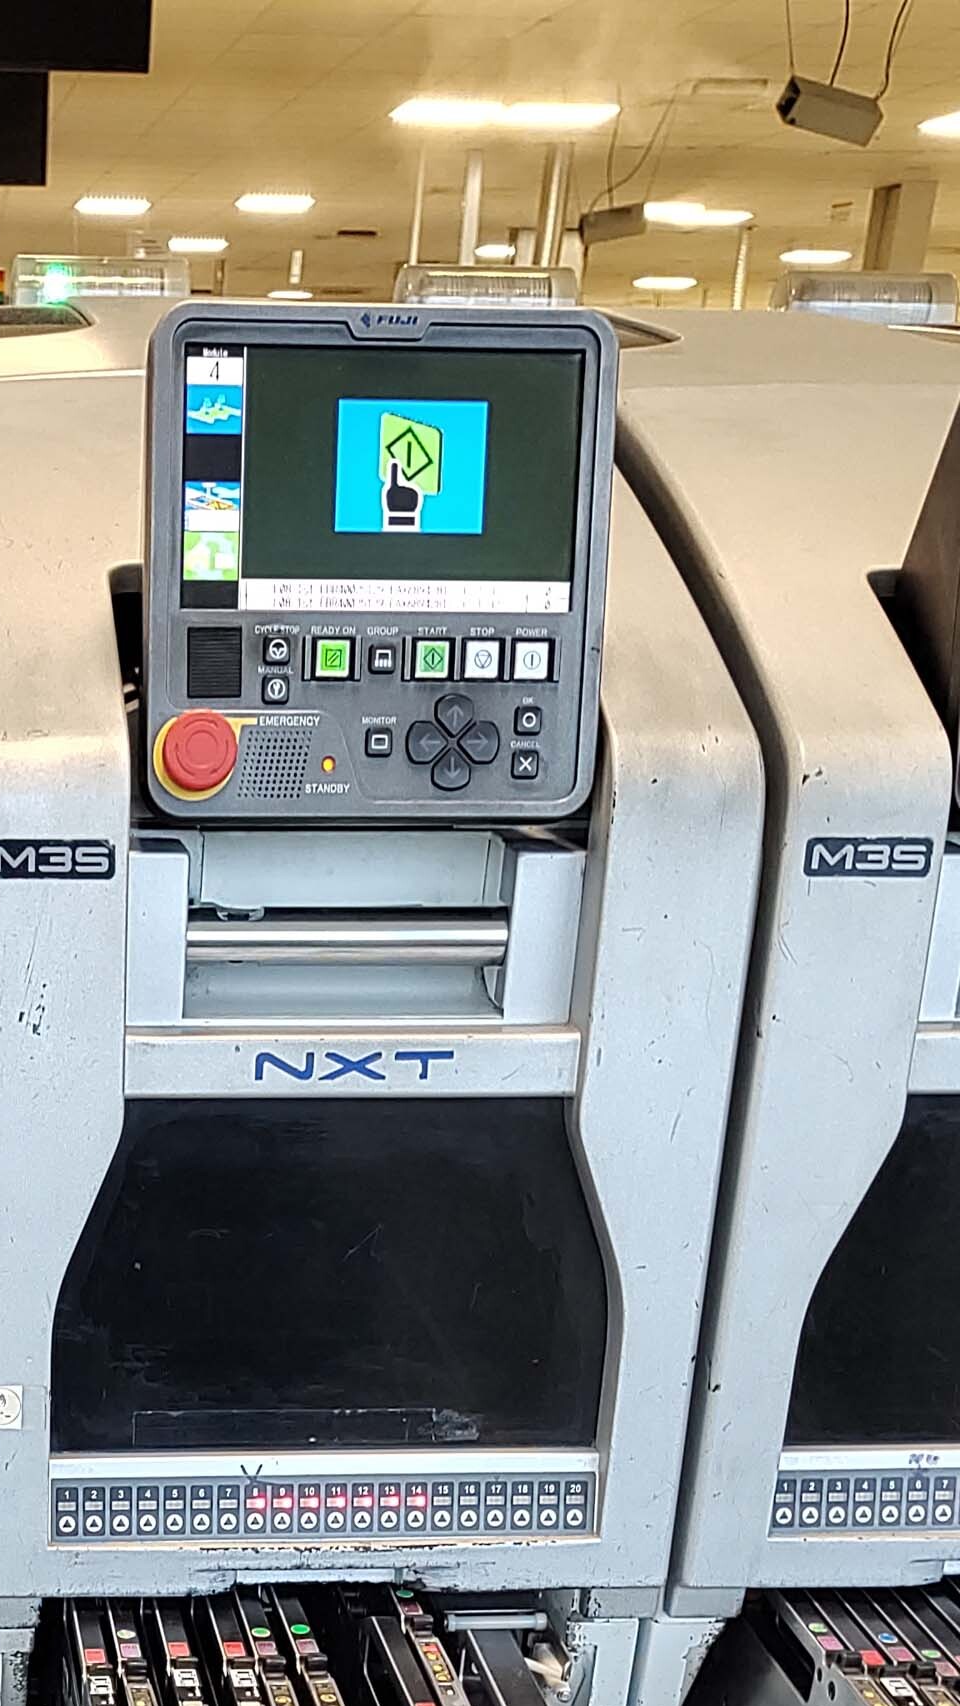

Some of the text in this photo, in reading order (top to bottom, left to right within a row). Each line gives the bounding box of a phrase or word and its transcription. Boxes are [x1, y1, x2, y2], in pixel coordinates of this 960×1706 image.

[377, 315, 418, 325] FUJI
[311, 625, 356, 635] READY ON
[367, 626, 399, 636] GROUP
[417, 626, 447, 636] START
[469, 626, 494, 637] STOP
[515, 627, 548, 637] POWER
[257, 665, 294, 674] MANUAL
[259, 716, 320, 727] EMERGENCY
[361, 716, 397, 725] MONITOR
[510, 740, 540, 749] CANCEL
[305, 783, 350, 794] STANDBY
[809, 844, 928, 871] M3S
[254, 1049, 454, 1081] NXT
[304, 1486, 315, 1497] 10
[331, 1486, 341, 1496] 11
[357, 1485, 369, 1496] 12
[384, 1485, 396, 1495] 13
[410, 1485, 422, 1495] 14
[437, 1485, 449, 1495] 15
[464, 1484, 476, 1494] 16
[491, 1484, 502, 1494] 17
[517, 1484, 528, 1494] 18
[544, 1484, 555, 1494] 19
[569, 1483, 582, 1493] 20
